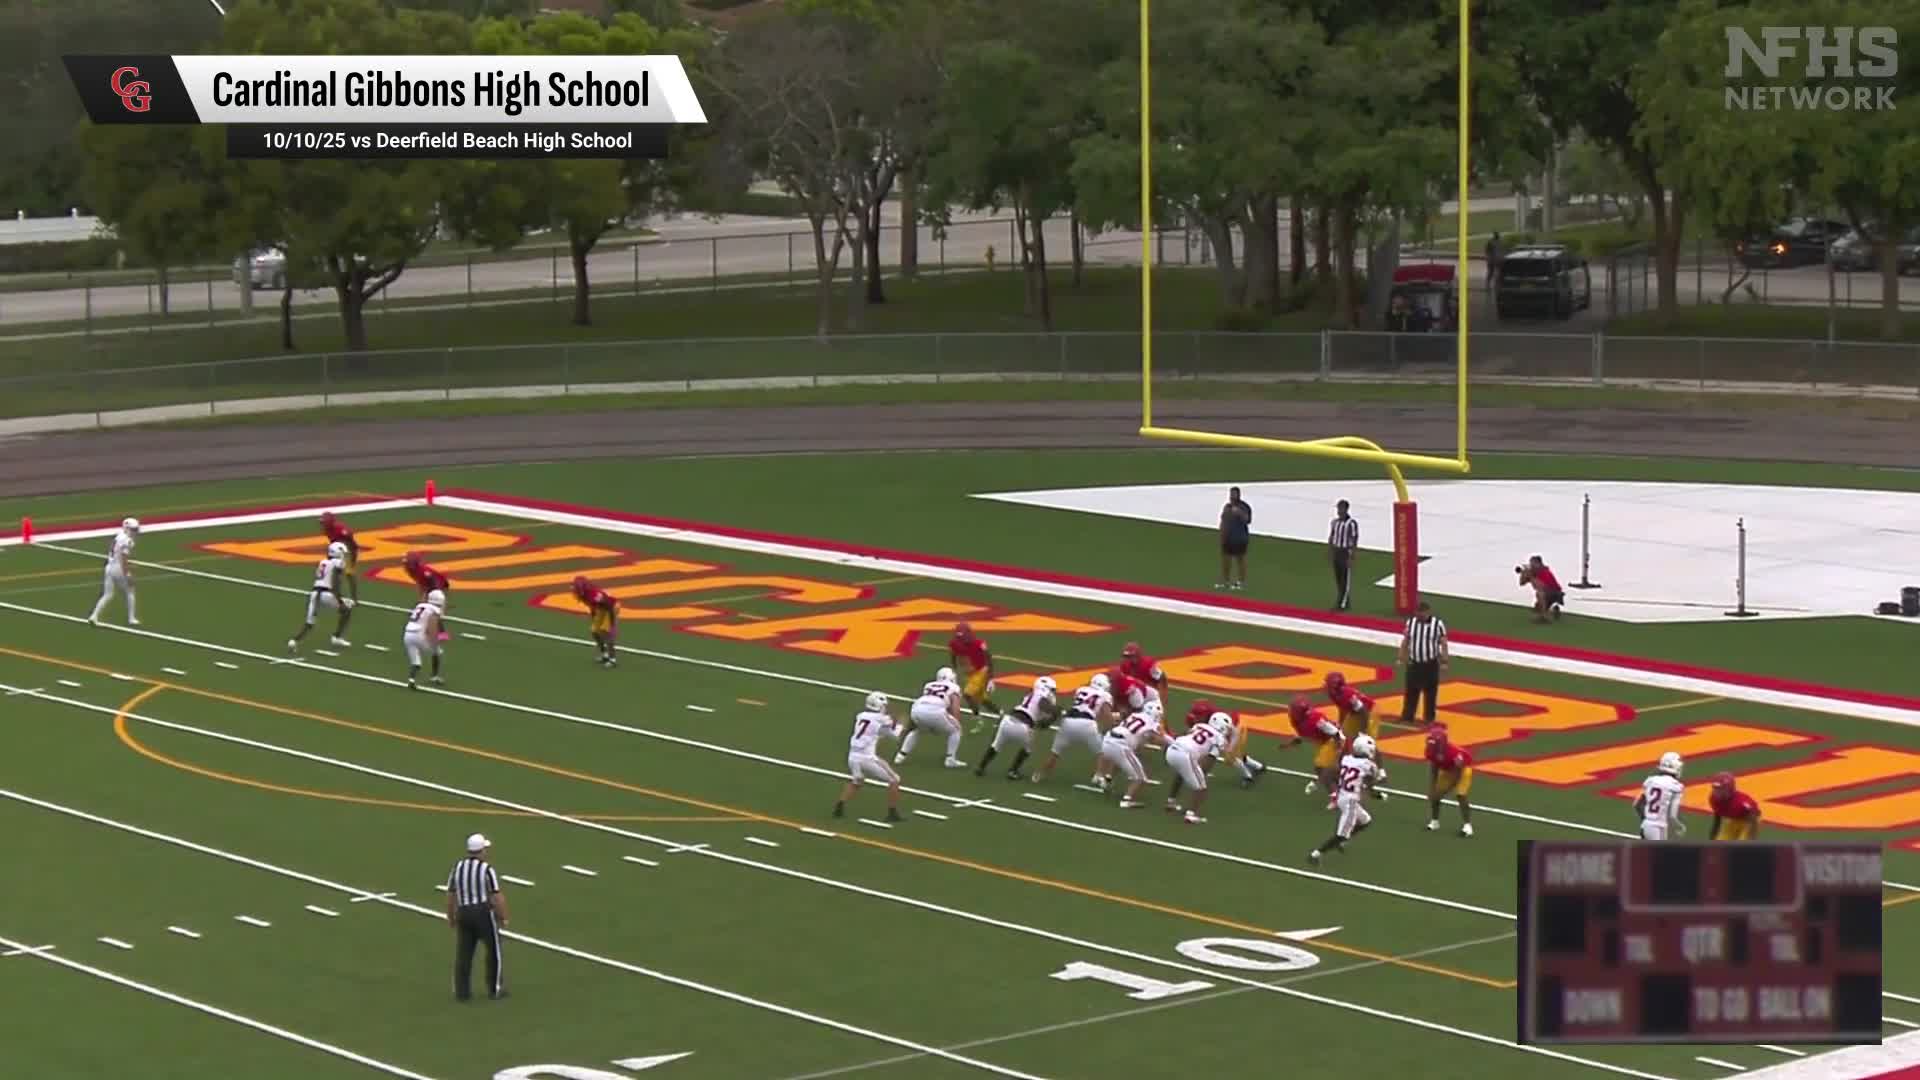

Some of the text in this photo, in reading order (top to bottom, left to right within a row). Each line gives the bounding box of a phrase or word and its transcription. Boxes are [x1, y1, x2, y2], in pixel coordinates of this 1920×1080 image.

[856, 719, 871, 739] 7
[1649, 787, 1662, 813] 2
[1545, 852, 1615, 886] HOME
[1048, 937, 1321, 1000] 10
[1563, 989, 1622, 1023] DOWN
[1693, 987, 1720, 1021] TO
